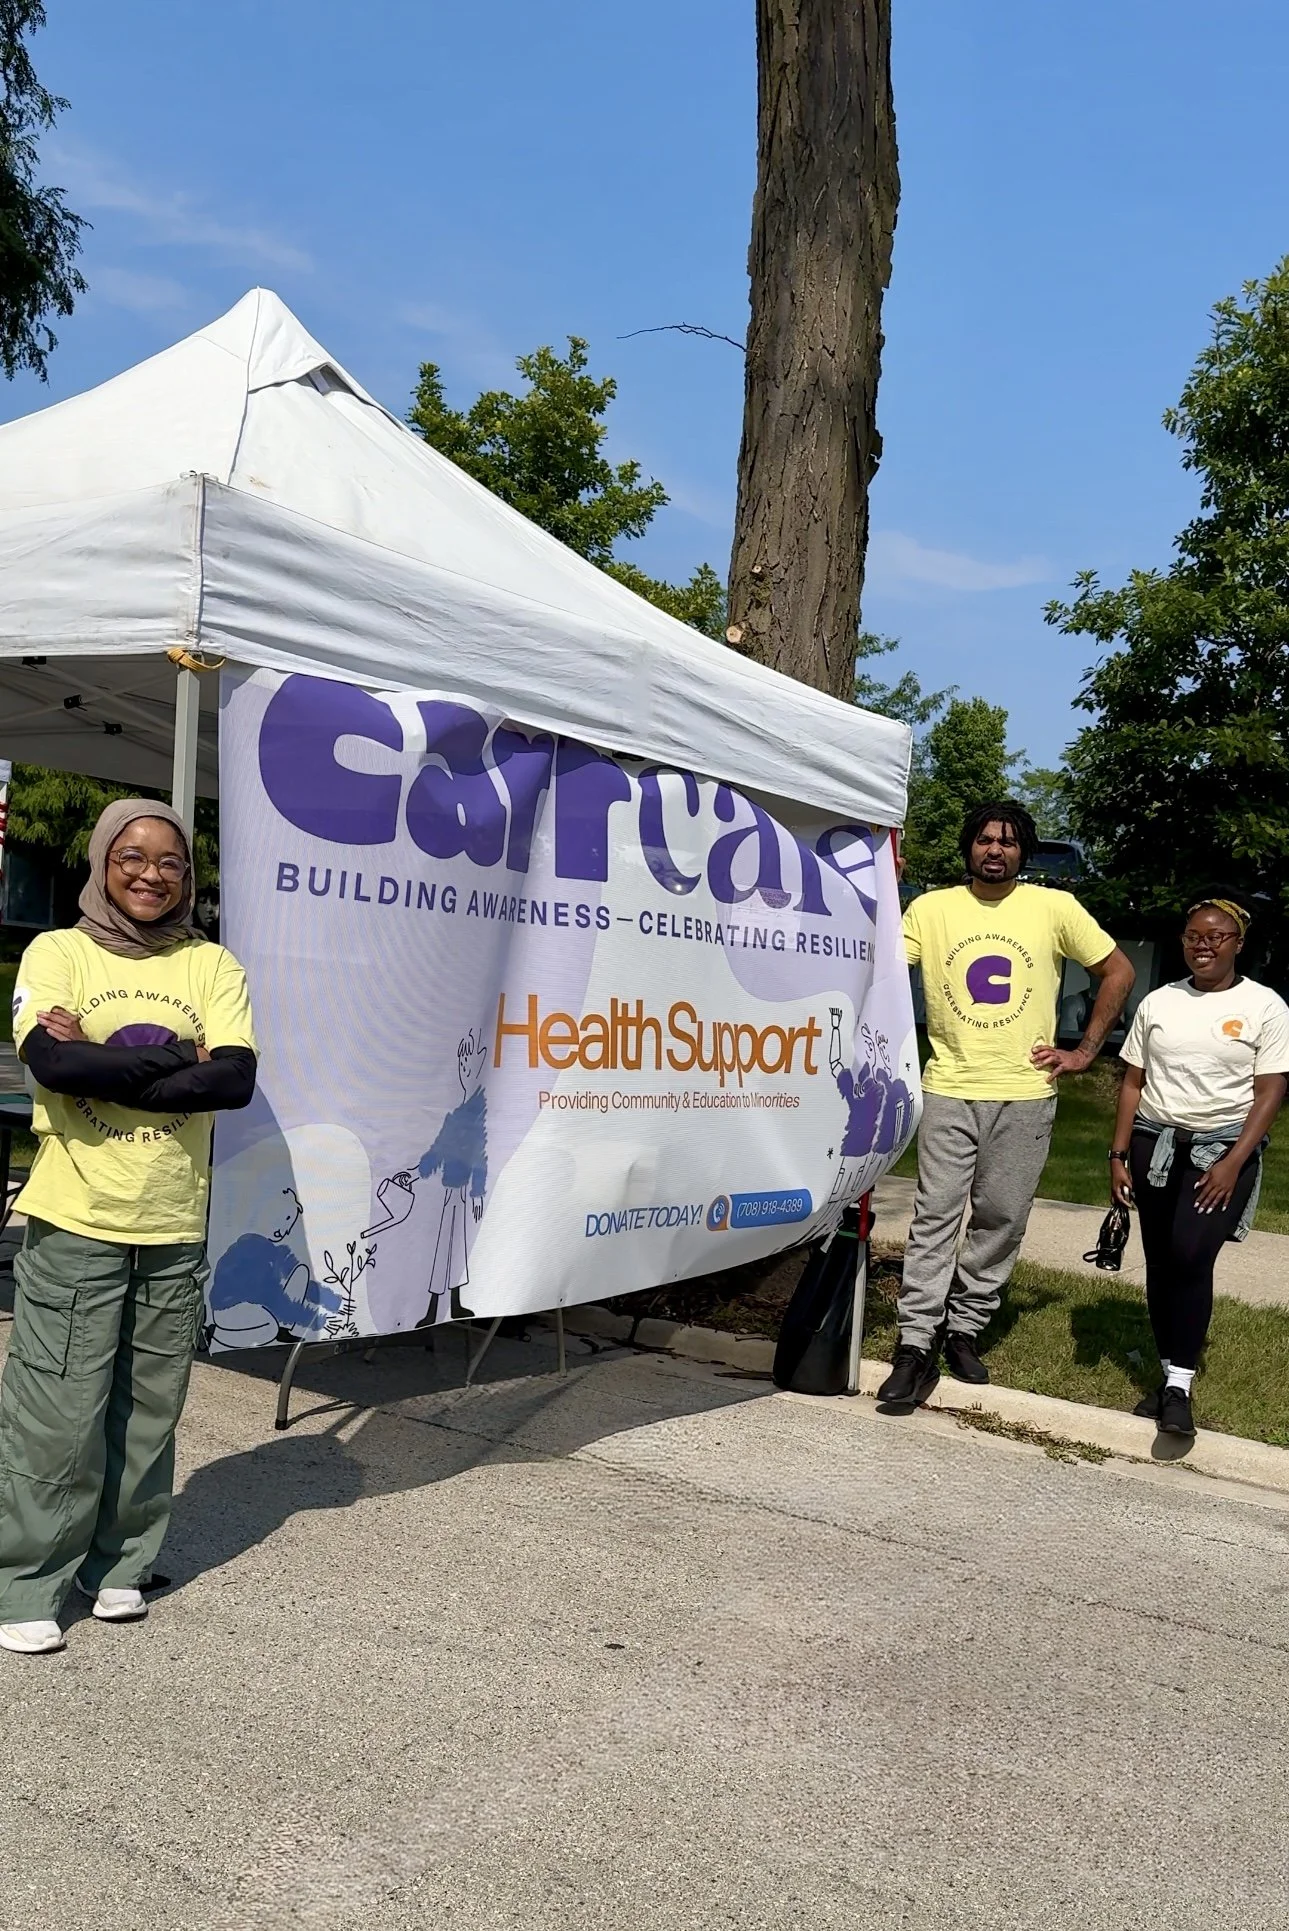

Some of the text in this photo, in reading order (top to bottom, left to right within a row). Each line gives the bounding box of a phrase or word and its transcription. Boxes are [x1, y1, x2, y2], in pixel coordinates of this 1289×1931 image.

[276, 861, 458, 914] BUILDING
[795, 931, 877, 965] RESILIEN
[945, 933, 1034, 969] BUILDING AWARENESS
[77, 989, 129, 1021] ILDING
[943, 983, 1033, 1029] CELEBRATING RESILIENCE
[494, 993, 822, 1087] Health Support
[75, 1098, 192, 1143] BRATING RESILI
[538, 1090, 609, 1114] Providing
[611, 1090, 681, 1113] Community
[692, 1091, 741, 1109] Education
[742, 1091, 751, 1109] to
[750, 1091, 800, 1109] Minorities
[585, 1204, 704, 1238] DONATE TODAY!
